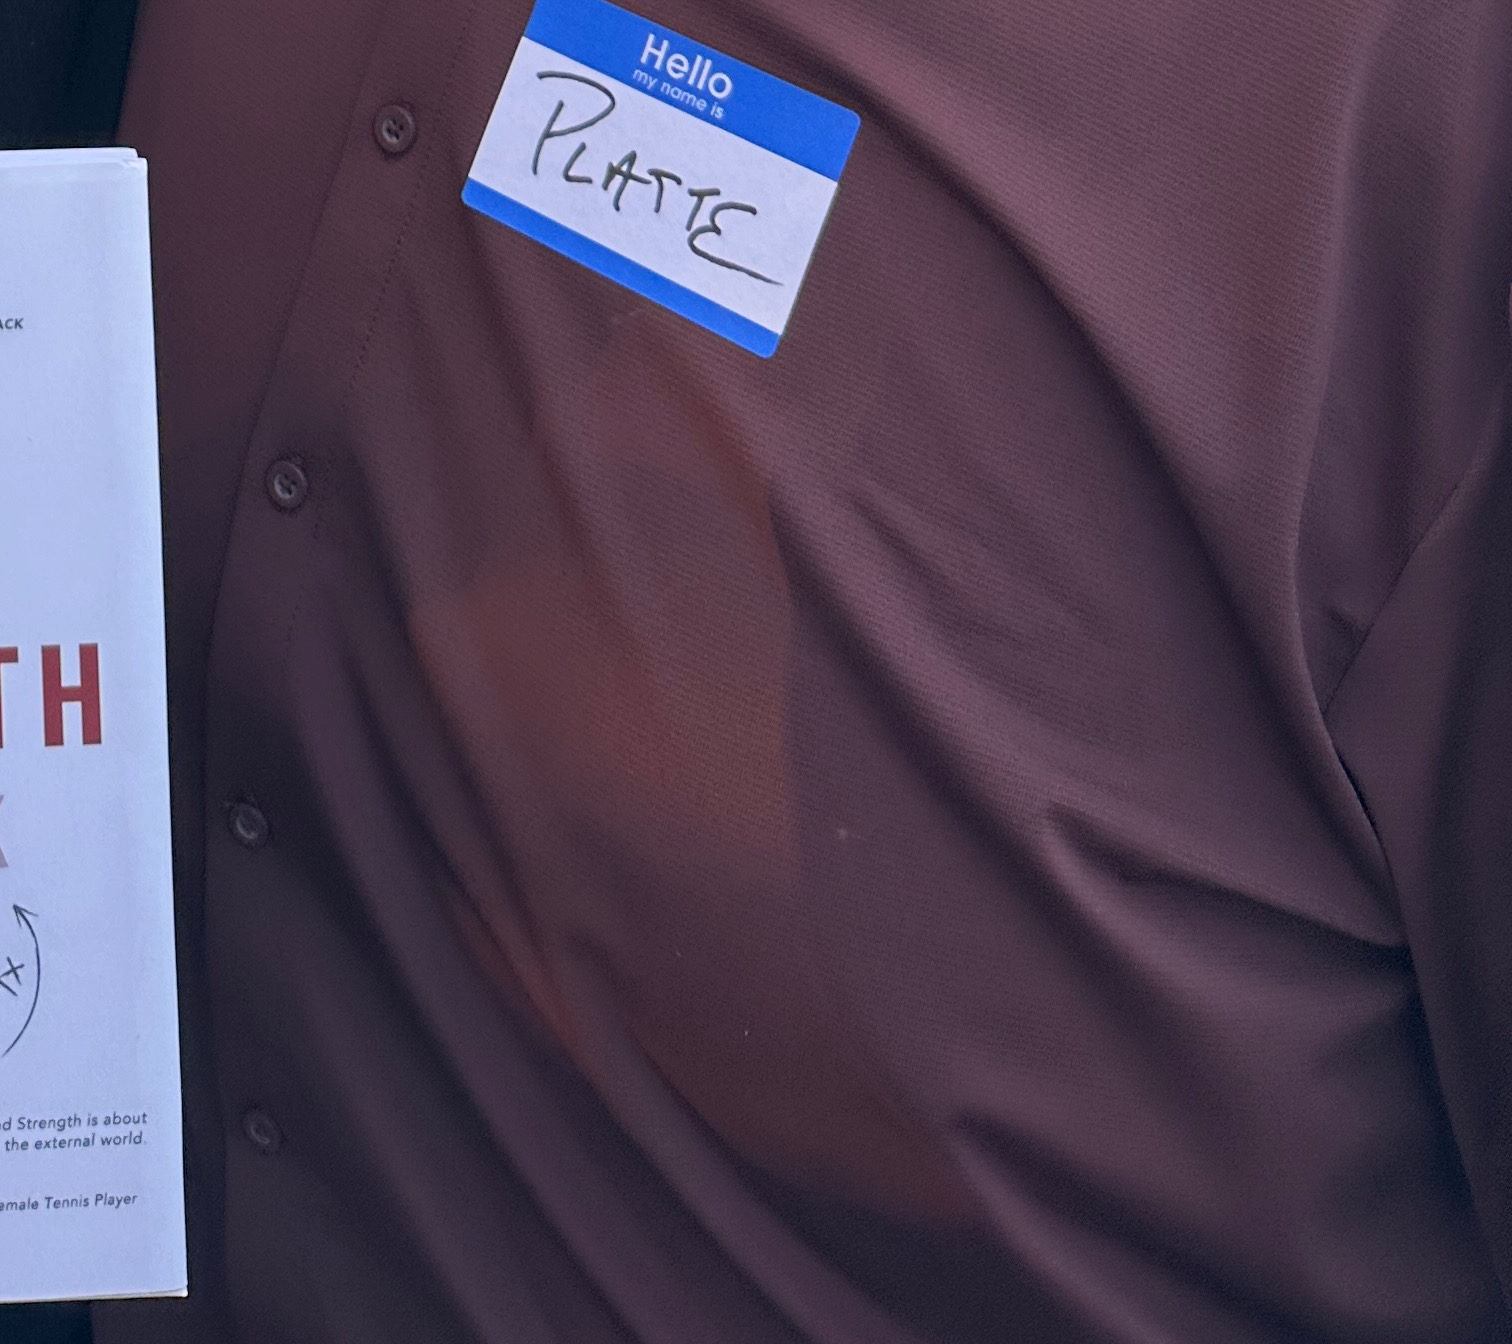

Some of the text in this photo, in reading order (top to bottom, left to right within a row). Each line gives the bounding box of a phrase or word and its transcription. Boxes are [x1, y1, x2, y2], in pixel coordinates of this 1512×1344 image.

[640, 33, 733, 99] Hello
[632, 69, 724, 119] my name is
[532, 70, 785, 287] PLATTE
[17, 1116, 82, 1132] Strength
[87, 1114, 98, 1127] is
[103, 1111, 147, 1126] about
[5, 1137, 29, 1151] the
[34, 1133, 96, 1150] external
[100, 1131, 147, 1146] world.
[45, 1194, 89, 1209] Tennis
[95, 1192, 137, 1209] Player
